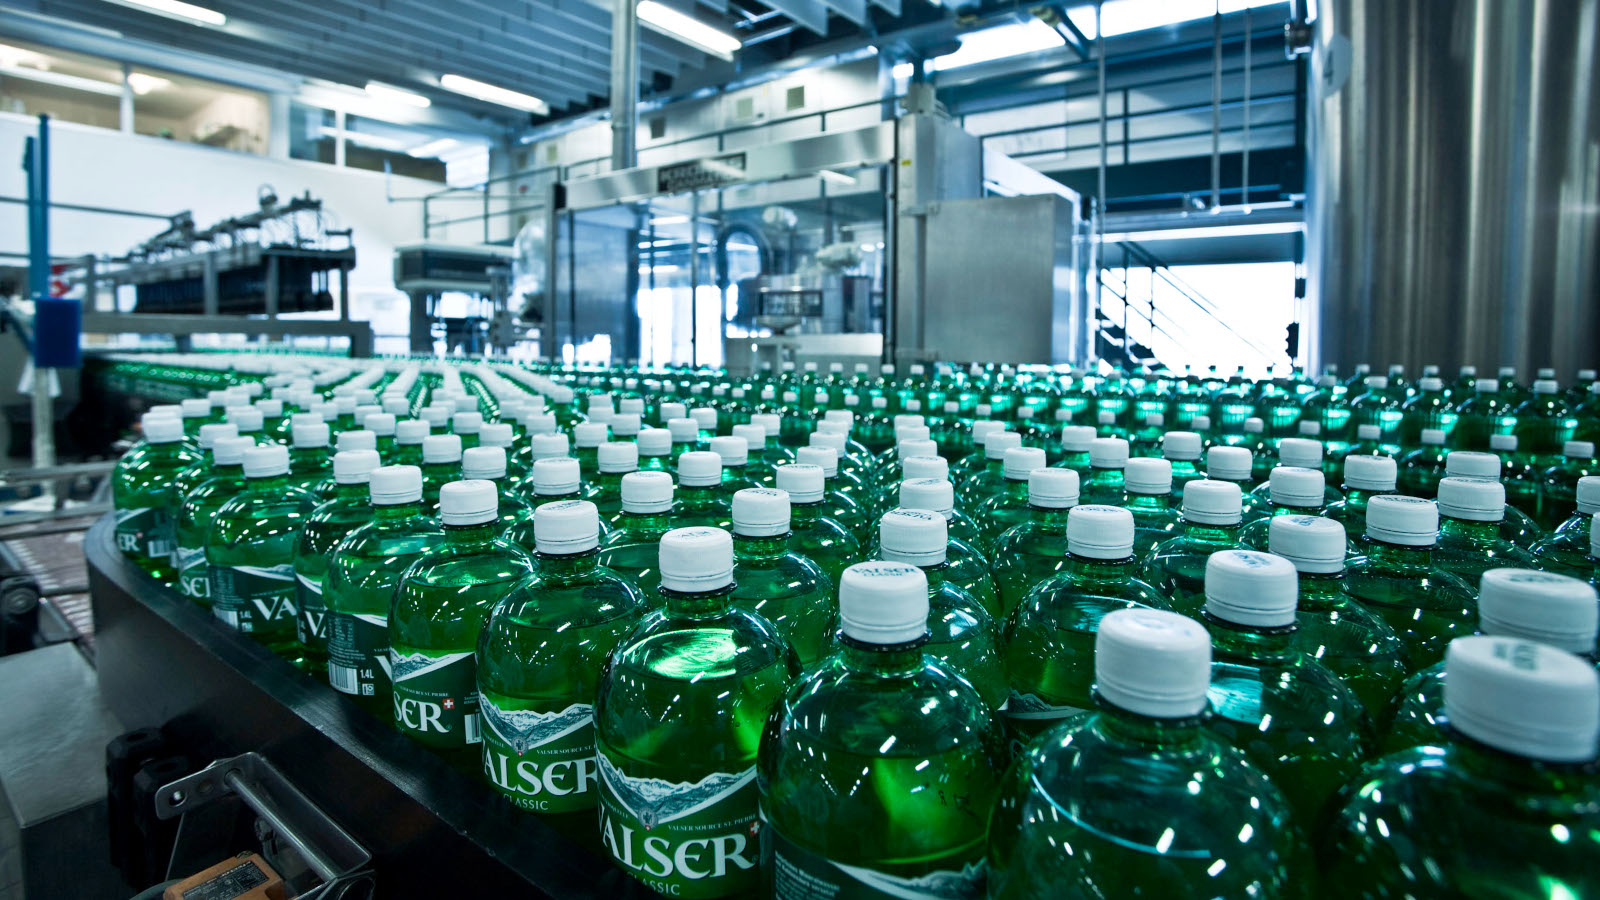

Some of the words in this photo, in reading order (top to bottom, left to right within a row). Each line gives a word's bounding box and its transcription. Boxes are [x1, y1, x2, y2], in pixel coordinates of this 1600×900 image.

[359, 668, 375, 679] 1.4L
[668, 824, 694, 832] VALSER
[694, 822, 722, 831] SOURCE
